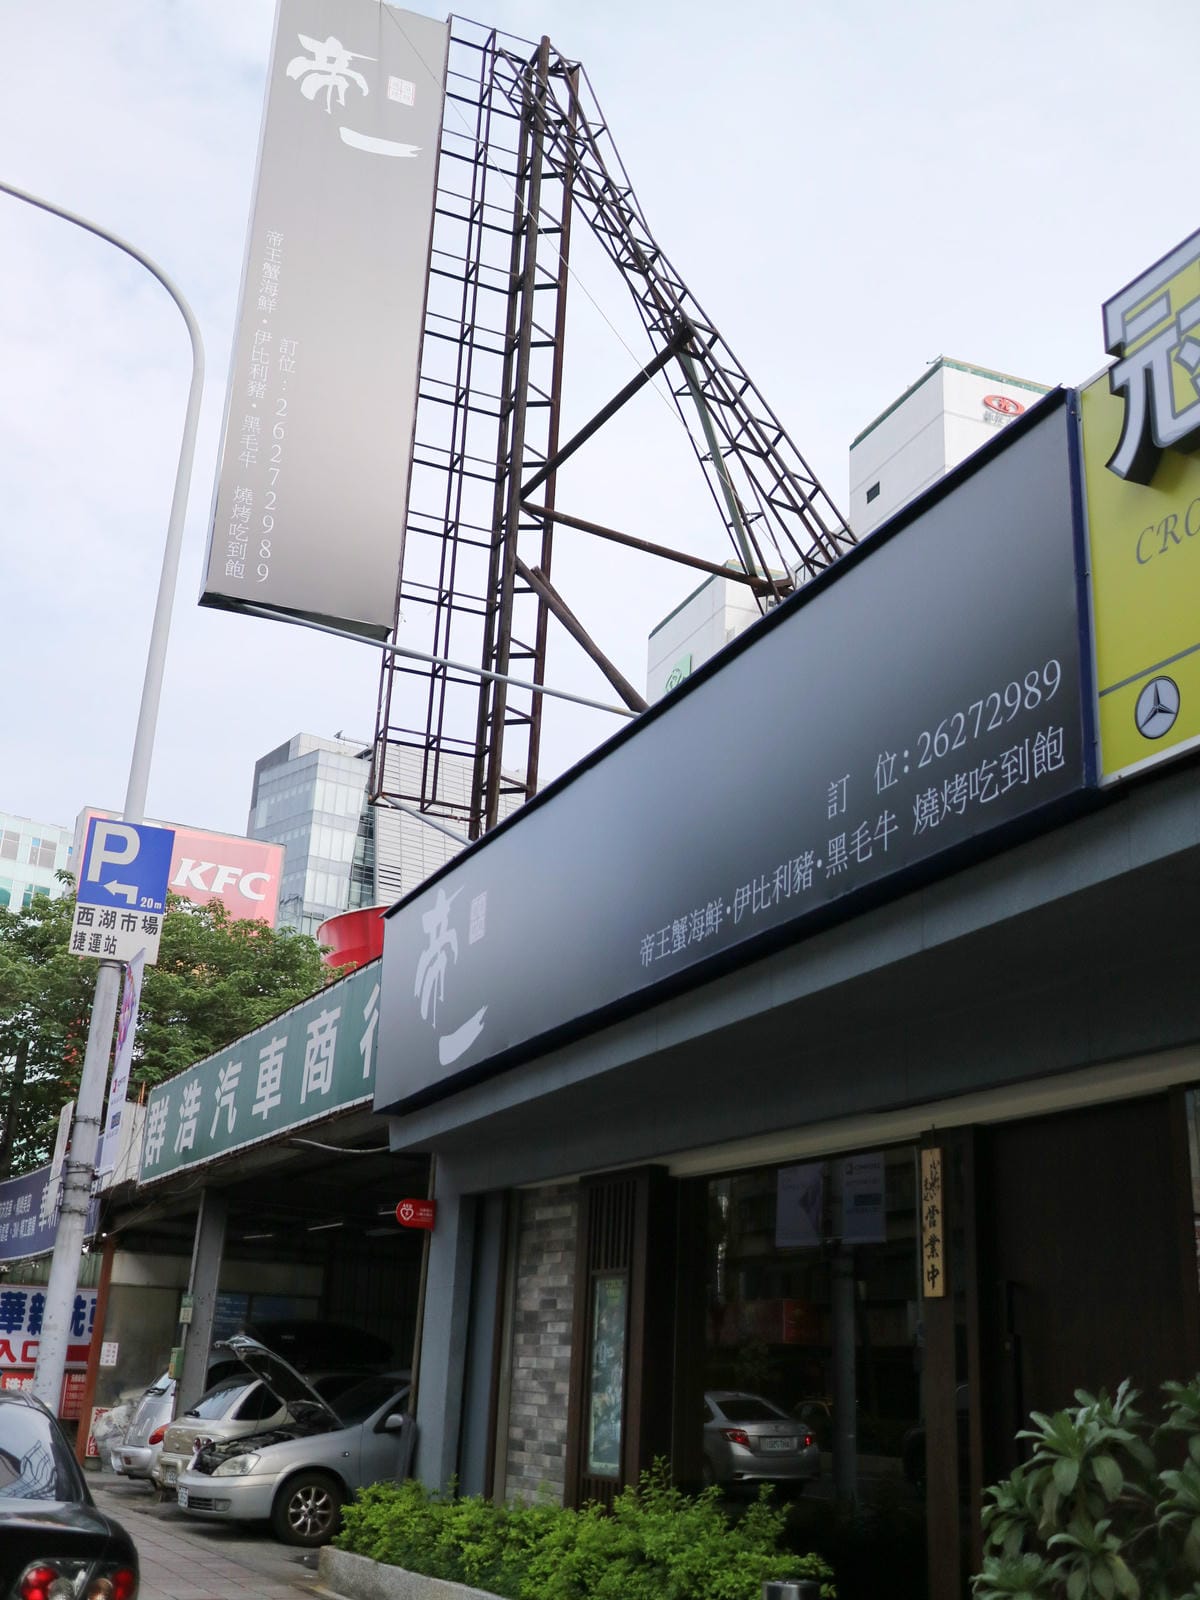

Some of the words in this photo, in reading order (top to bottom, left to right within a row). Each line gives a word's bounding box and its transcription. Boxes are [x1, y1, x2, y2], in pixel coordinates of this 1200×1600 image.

[912, 725, 1066, 835] 燒烤吃到飽
[86, 821, 141, 882] P
[171, 858, 271, 901] KFC
[76, 906, 159, 936] 西湖市場
[72, 931, 117, 956] 捷運站
